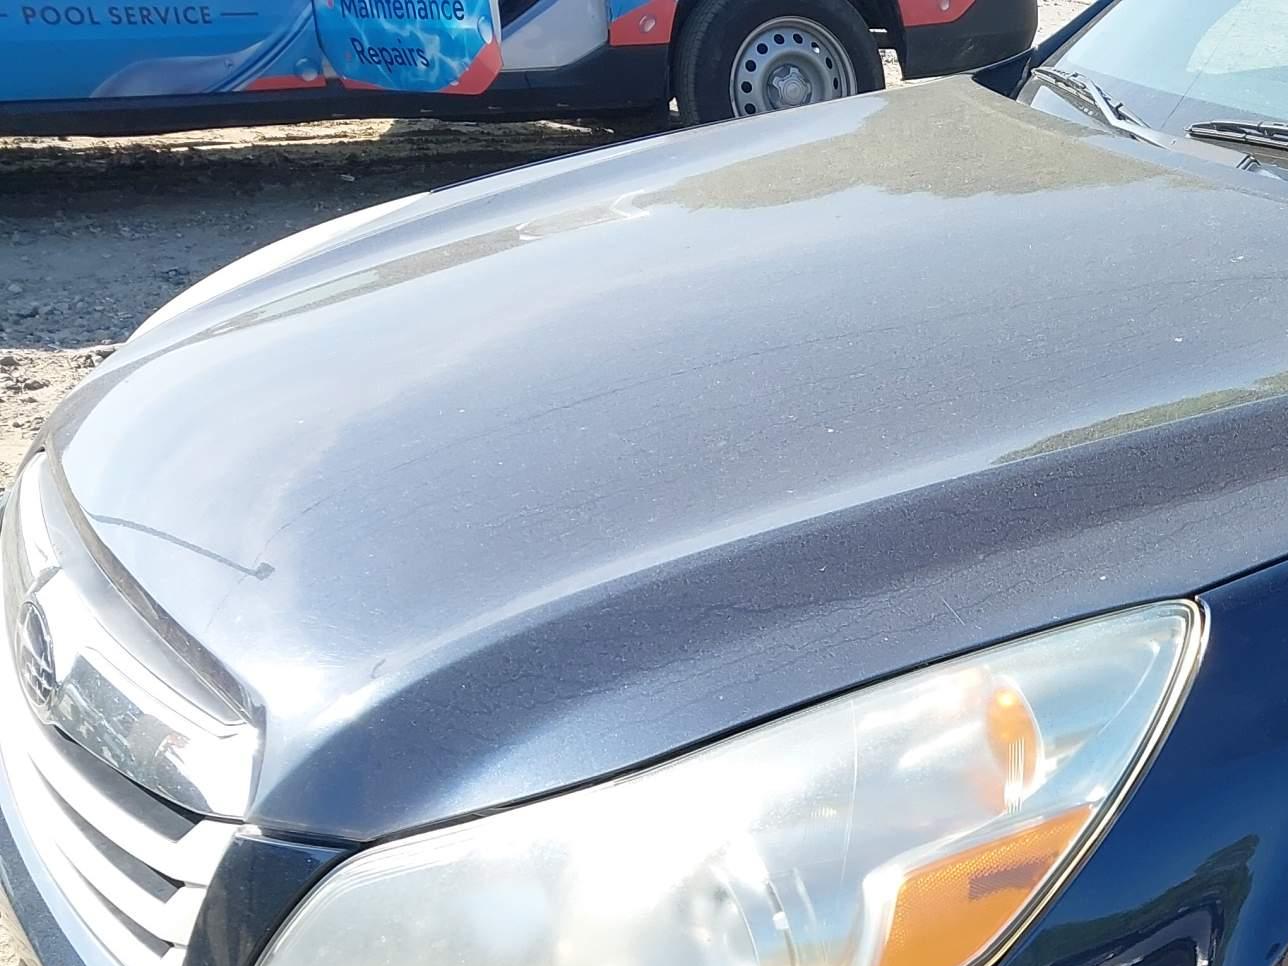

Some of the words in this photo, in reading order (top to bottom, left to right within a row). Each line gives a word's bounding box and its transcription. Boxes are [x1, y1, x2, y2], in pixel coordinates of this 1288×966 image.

[21, 6, 100, 25] POOL
[108, 6, 213, 25] SERVICE
[341, 0, 465, 21] Maintenance
[350, 38, 430, 73] Repairs
